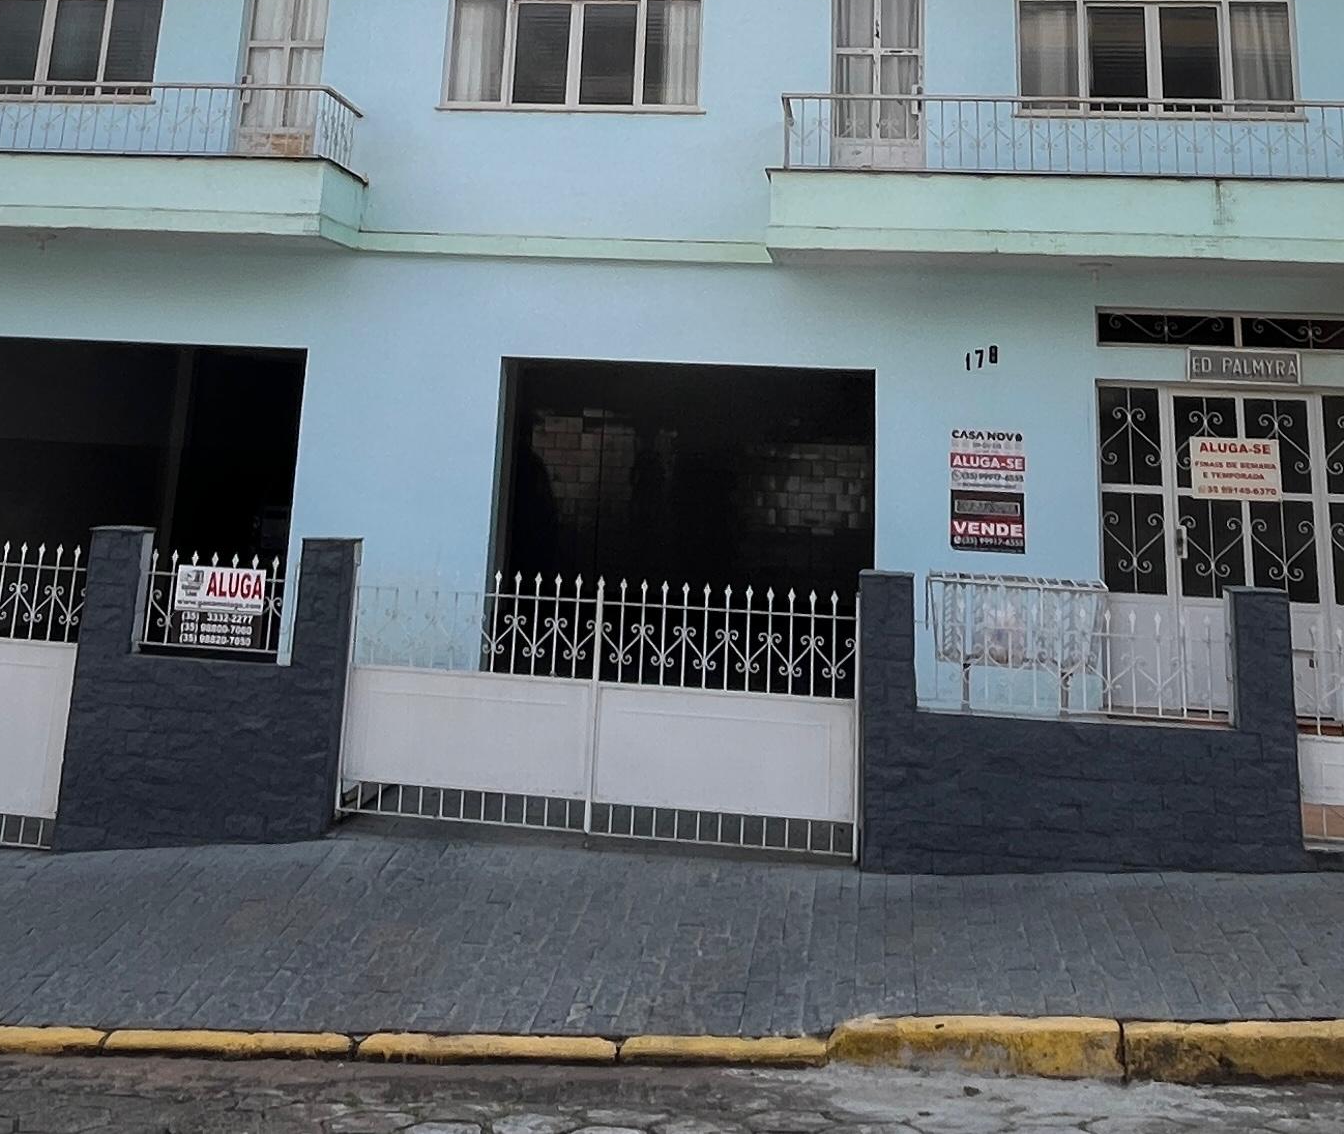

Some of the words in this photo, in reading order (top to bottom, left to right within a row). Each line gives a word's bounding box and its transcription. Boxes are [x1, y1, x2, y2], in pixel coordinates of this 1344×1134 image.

[965, 345, 998, 371] 178
[1222, 357, 1297, 375] PALMYRA
[951, 430, 984, 441] CASA
[1199, 442, 1271, 455] ALUGA-SE
[952, 455, 1024, 469] ALUGA-SE
[1211, 472, 1265, 480] TEMPORADA
[953, 521, 1023, 537] VENDE
[206, 572, 262, 599] ALUGA
[180, 622, 198, 633] (35)
[179, 633, 197, 644] (35)
